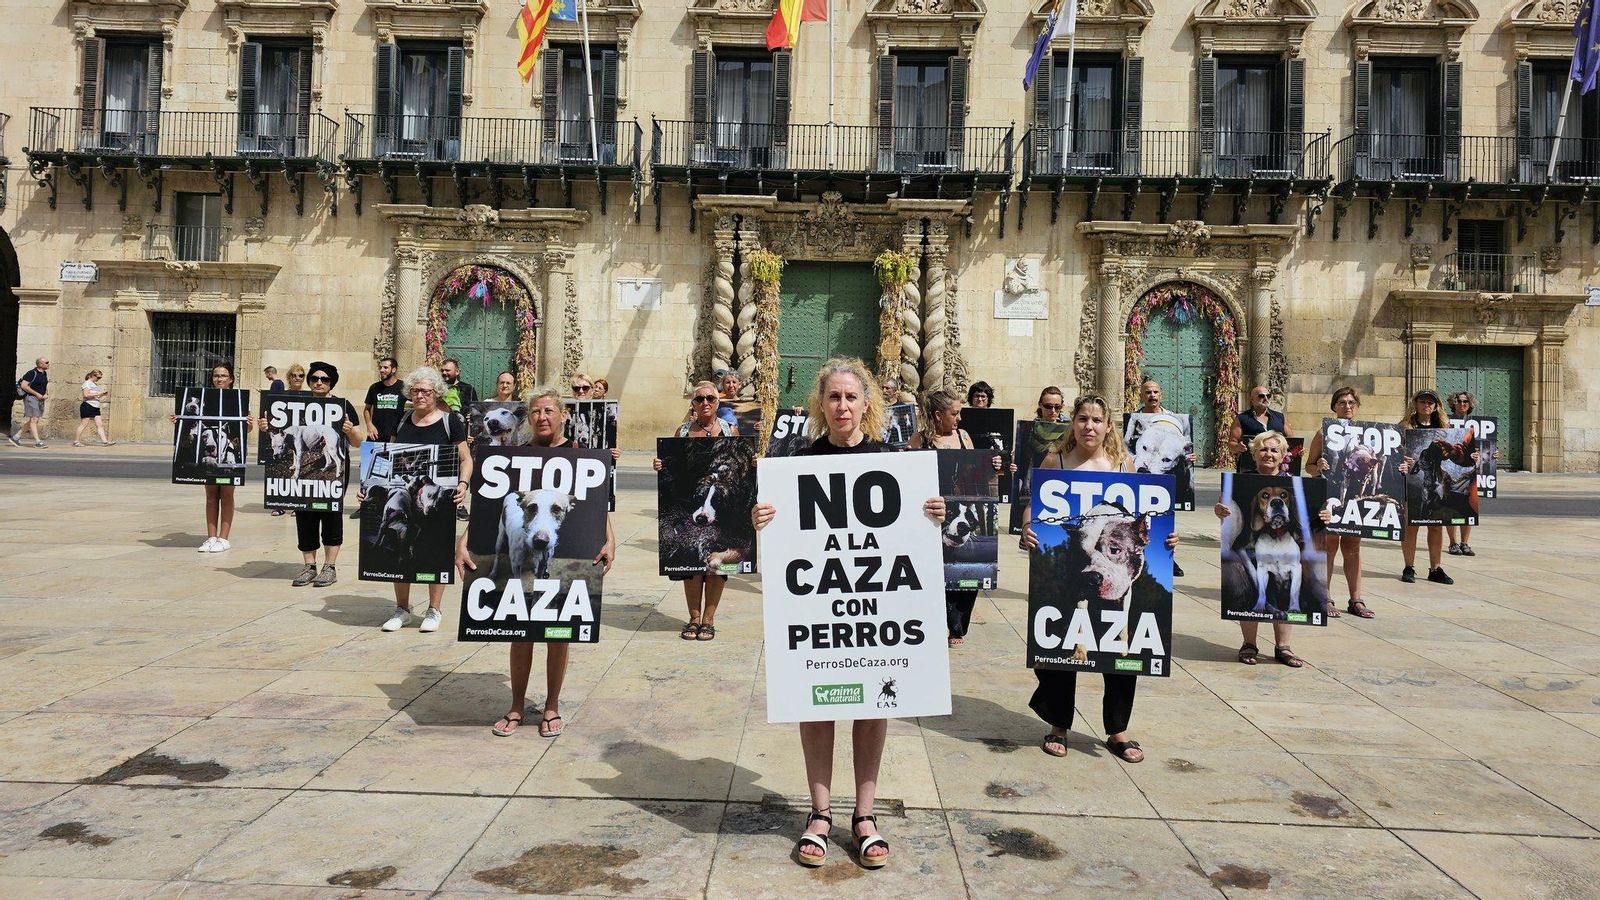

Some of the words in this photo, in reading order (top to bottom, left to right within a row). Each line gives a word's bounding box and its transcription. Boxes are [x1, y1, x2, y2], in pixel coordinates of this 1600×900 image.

[270, 401, 343, 428] STOP
[1449, 418, 1496, 439] TOP
[1327, 424, 1402, 456] STOP
[266, 477, 343, 498] HUNTING
[478, 455, 606, 500] STOP
[797, 470, 902, 531] NO
[1037, 479, 1172, 530] STOP
[1326, 497, 1402, 529] CAZA
[824, 534, 842, 552] A
[848, 533, 880, 551] LA
[363, 570, 404, 580] PerrosDeCaza.org
[664, 564, 707, 572] PerrosDeCaza.org
[785, 554, 922, 596] CAZA
[467, 578, 594, 622] CAZA
[831, 598, 878, 617] CON
[1227, 609, 1273, 619] PerrosDeCaza.org
[465, 627, 527, 638] PerrosDeCaza.org
[788, 620, 925, 651] PERROS
[1034, 605, 1166, 656] CAZA
[805, 657, 909, 670] PerrosDeCaza.org
[1034, 655, 1096, 668] PerrosDeCaza.org
[829, 686, 861, 696] anima
[829, 694, 861, 703] naturalis
[876, 701, 898, 709] CAS
